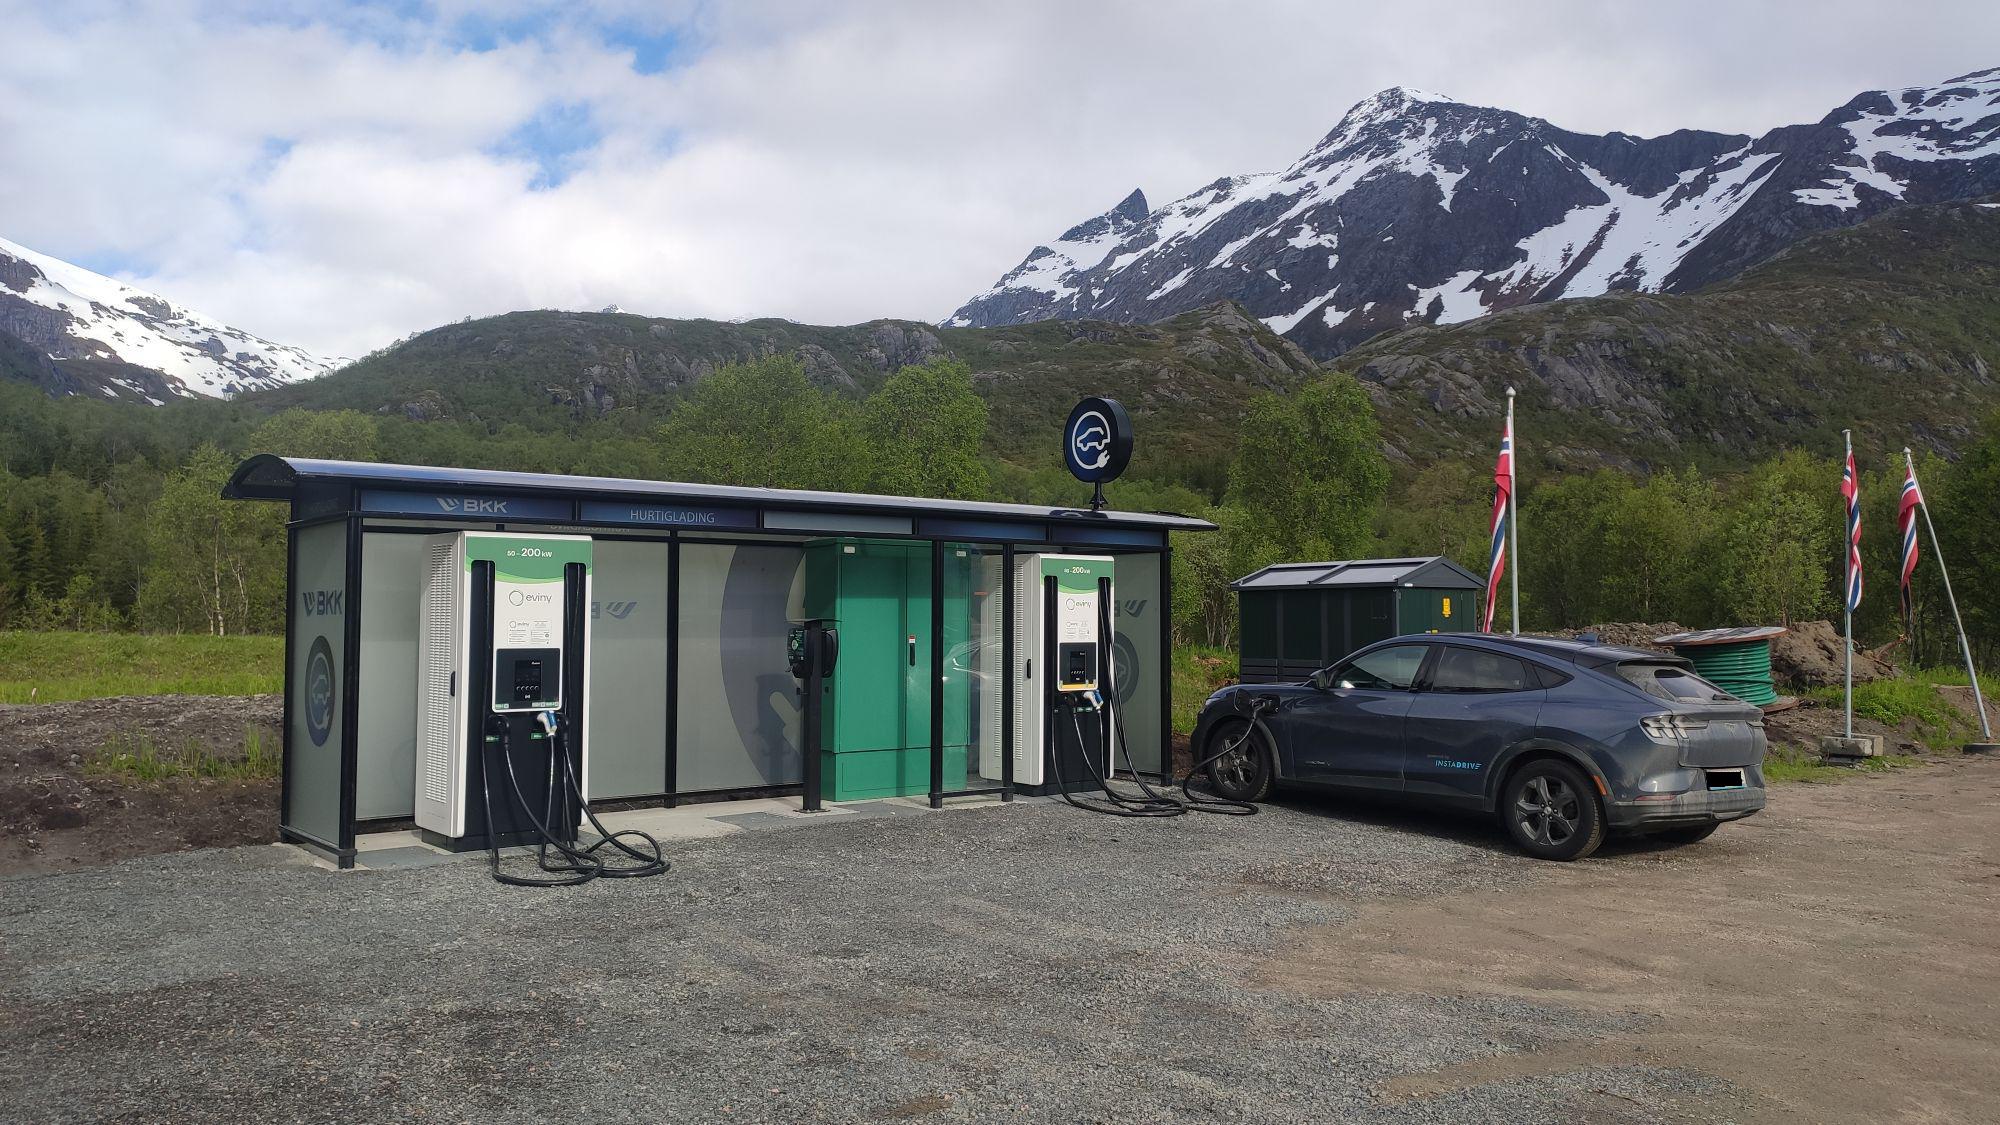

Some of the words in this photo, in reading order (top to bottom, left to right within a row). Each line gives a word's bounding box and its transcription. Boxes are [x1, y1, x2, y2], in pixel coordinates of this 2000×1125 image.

[463, 498, 508, 514] BKK
[630, 508, 716, 523] HURTIGLADING
[521, 548, 541, 557] 200
[1072, 566, 1084, 574] 200
[316, 590, 343, 616] BKK
[525, 592, 553, 605] eviny
[1435, 760, 1483, 770] INSTADRIVE
